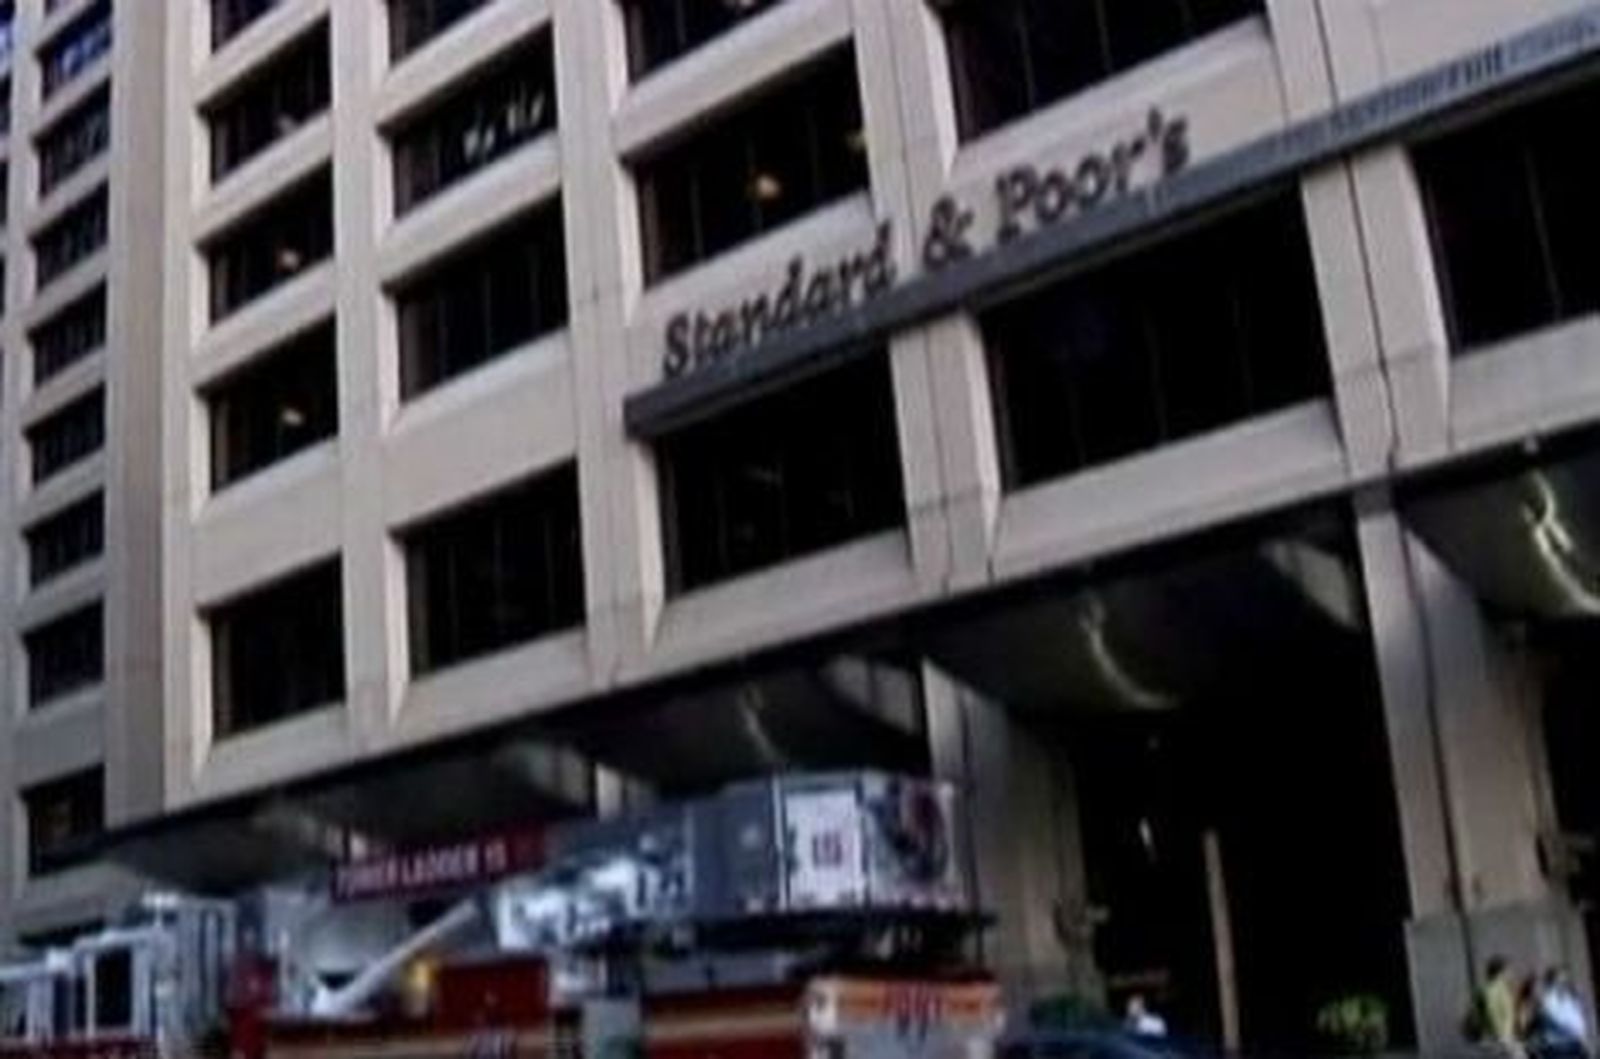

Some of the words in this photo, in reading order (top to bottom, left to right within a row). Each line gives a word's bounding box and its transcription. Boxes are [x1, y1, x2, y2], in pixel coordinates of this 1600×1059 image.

[663, 219, 896, 376] Standard
[922, 196, 974, 270] &
[995, 107, 1190, 241] Poor's
